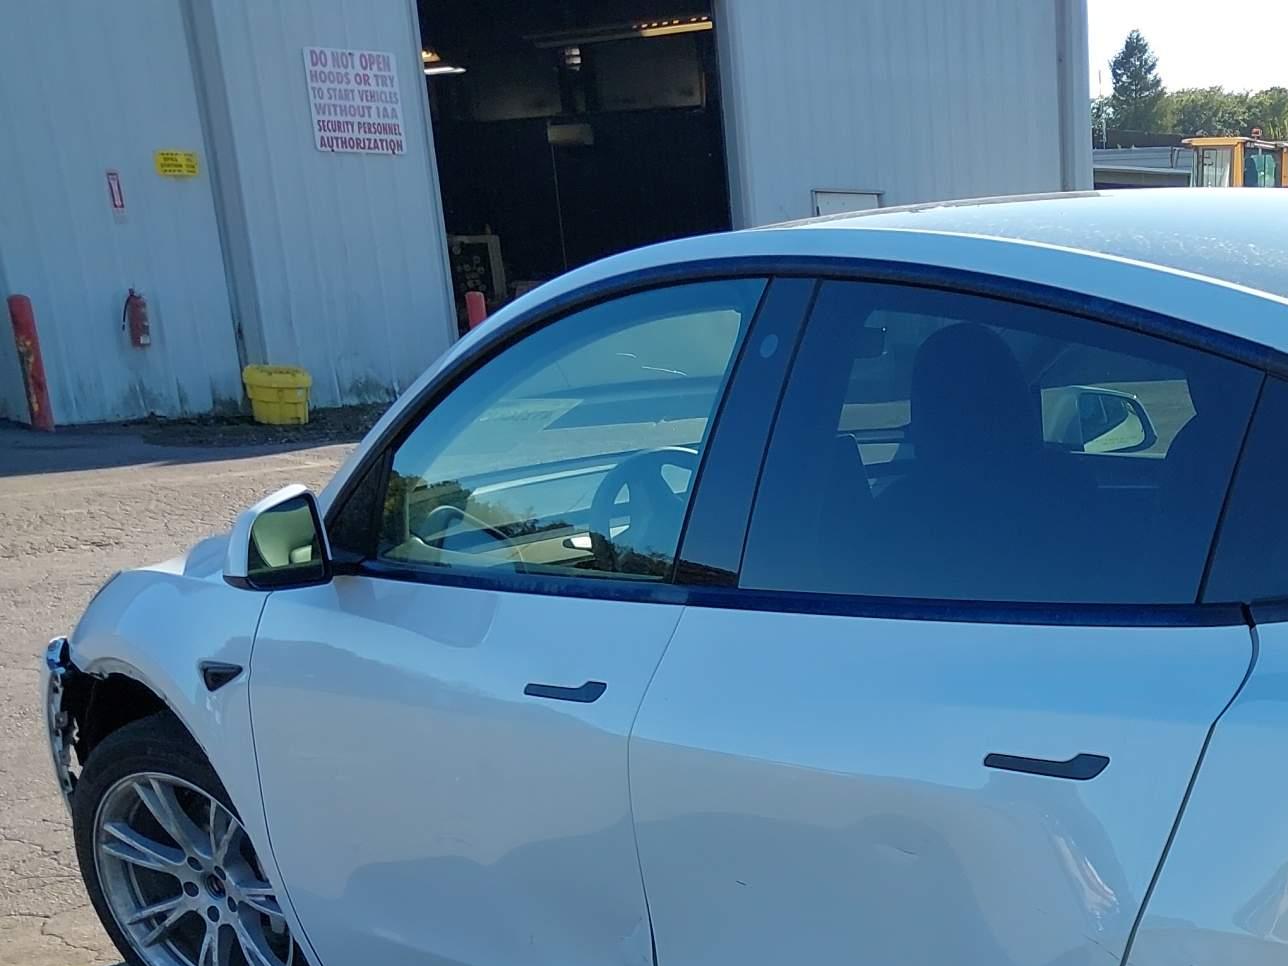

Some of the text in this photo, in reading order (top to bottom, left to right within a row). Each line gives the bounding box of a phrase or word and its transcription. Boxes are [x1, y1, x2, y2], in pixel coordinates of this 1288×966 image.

[309, 49, 391, 72] DO NOT OPEN
[309, 70, 395, 88] HOODS OR TRY
[310, 86, 399, 104] TO START VEHICLES
[314, 103, 398, 120] WITHOUT IAA
[317, 119, 402, 136] SECURITY PERSONNEL
[320, 135, 404, 153] AUTHORIZATION
